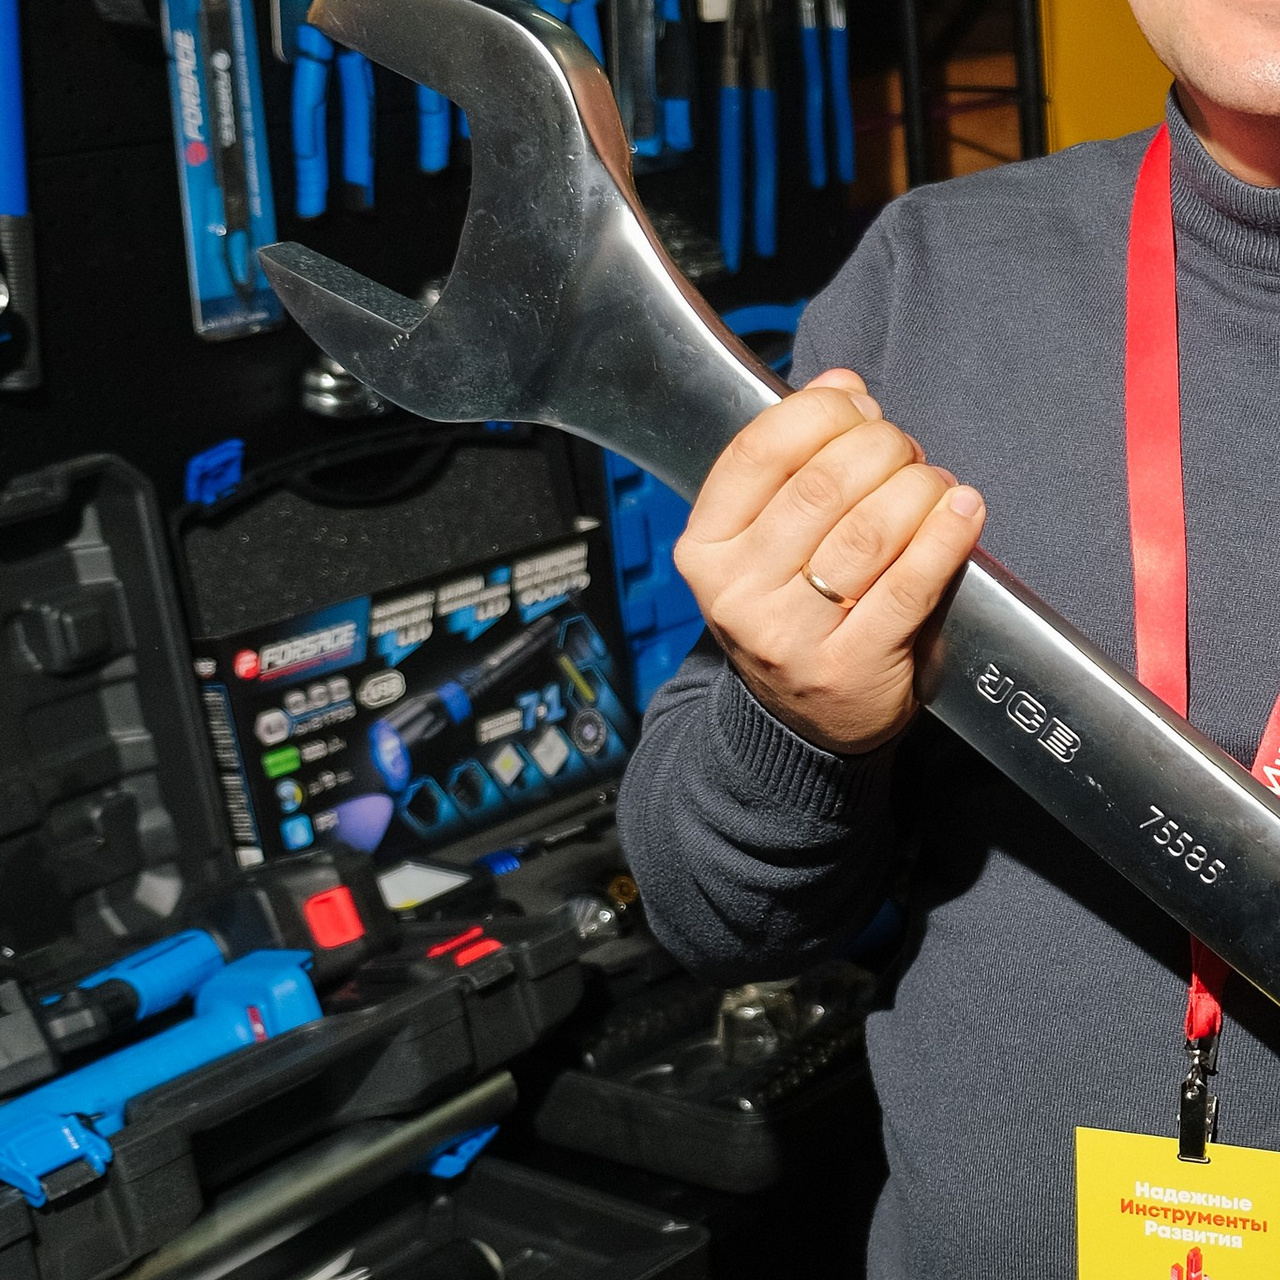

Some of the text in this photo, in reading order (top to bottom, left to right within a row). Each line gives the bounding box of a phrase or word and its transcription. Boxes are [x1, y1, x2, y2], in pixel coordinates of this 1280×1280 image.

[261, 622, 357, 669] FORSAGE
[976, 663, 1082, 763] JCB
[1139, 805, 1226, 884] 75585
[1120, 1198, 1268, 1232] Инструменты
[1135, 1180, 1253, 1211] Надежные
[1144, 1220, 1243, 1248] Развития
